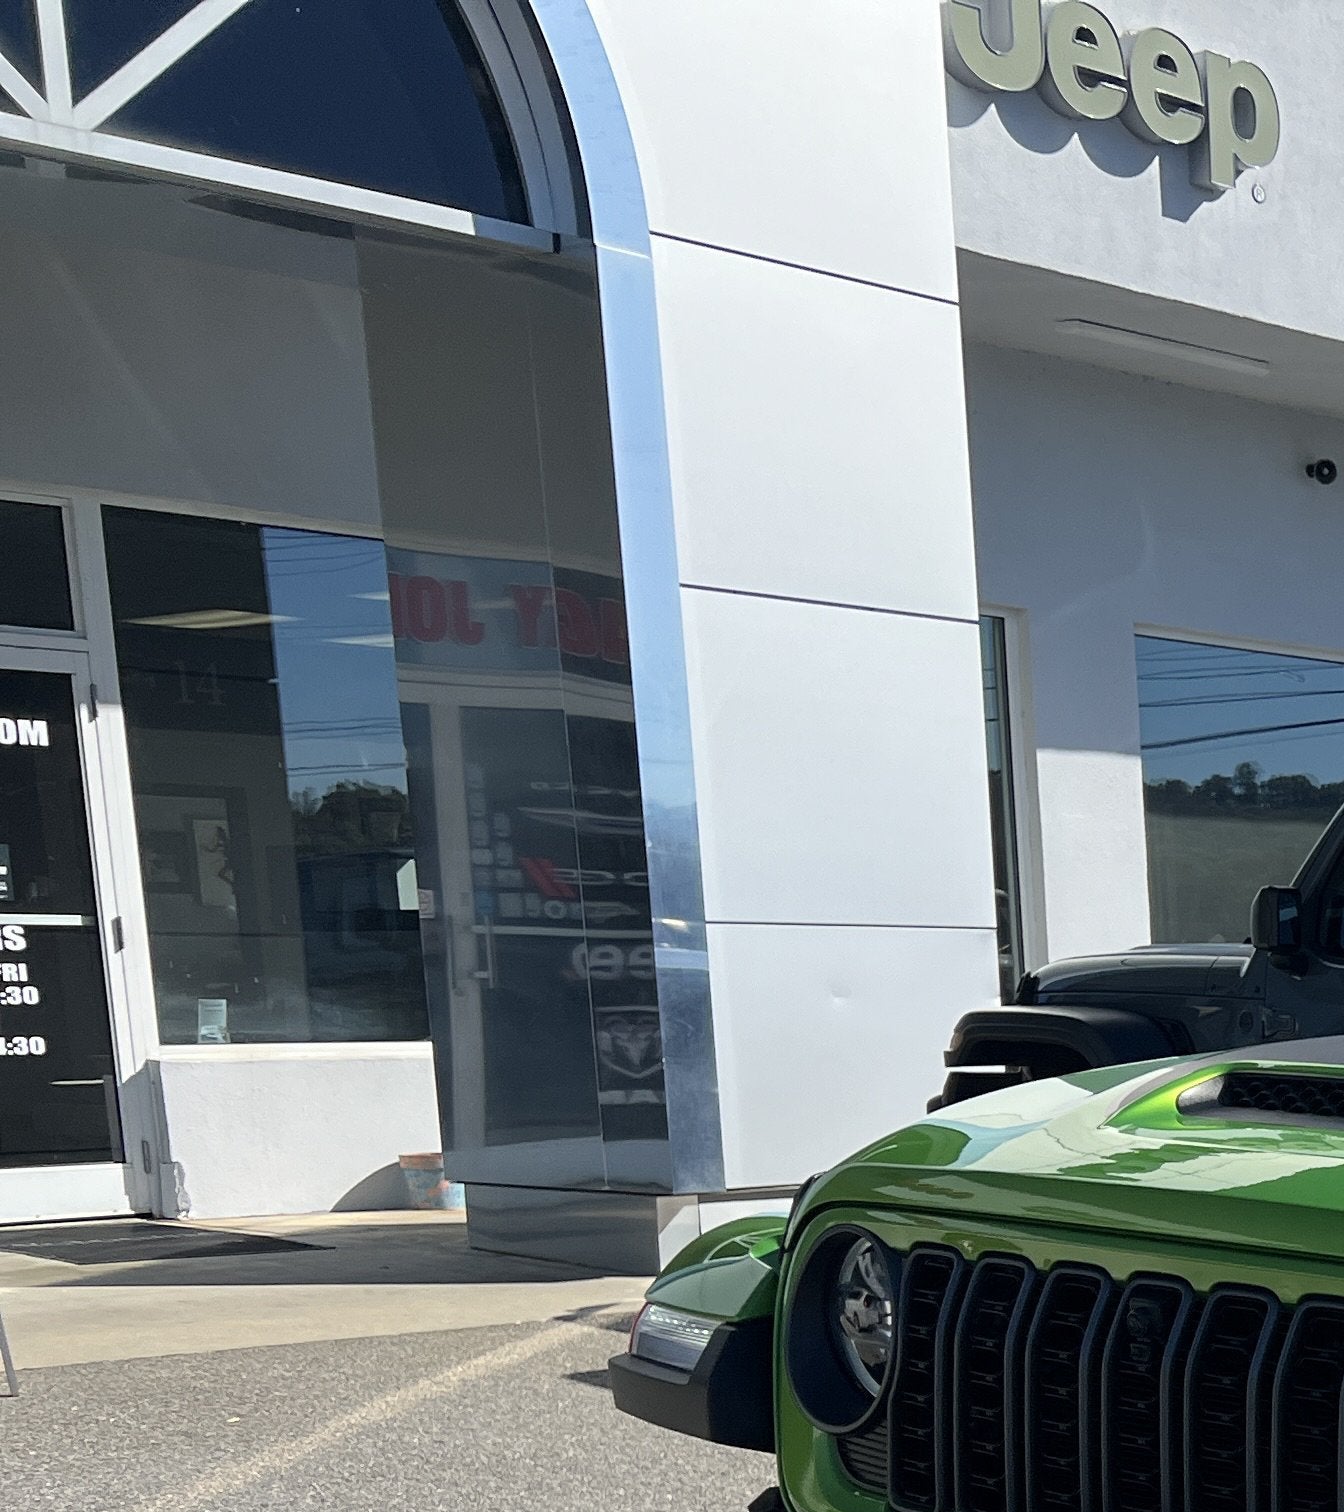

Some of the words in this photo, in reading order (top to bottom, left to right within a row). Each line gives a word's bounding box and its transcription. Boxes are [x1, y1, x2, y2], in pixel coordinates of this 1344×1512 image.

[947, 0, 1280, 190] Jeep
[0, 717, 50, 747] OM
[0, 962, 29, 982] RI
[0, 985, 40, 1005] :30
